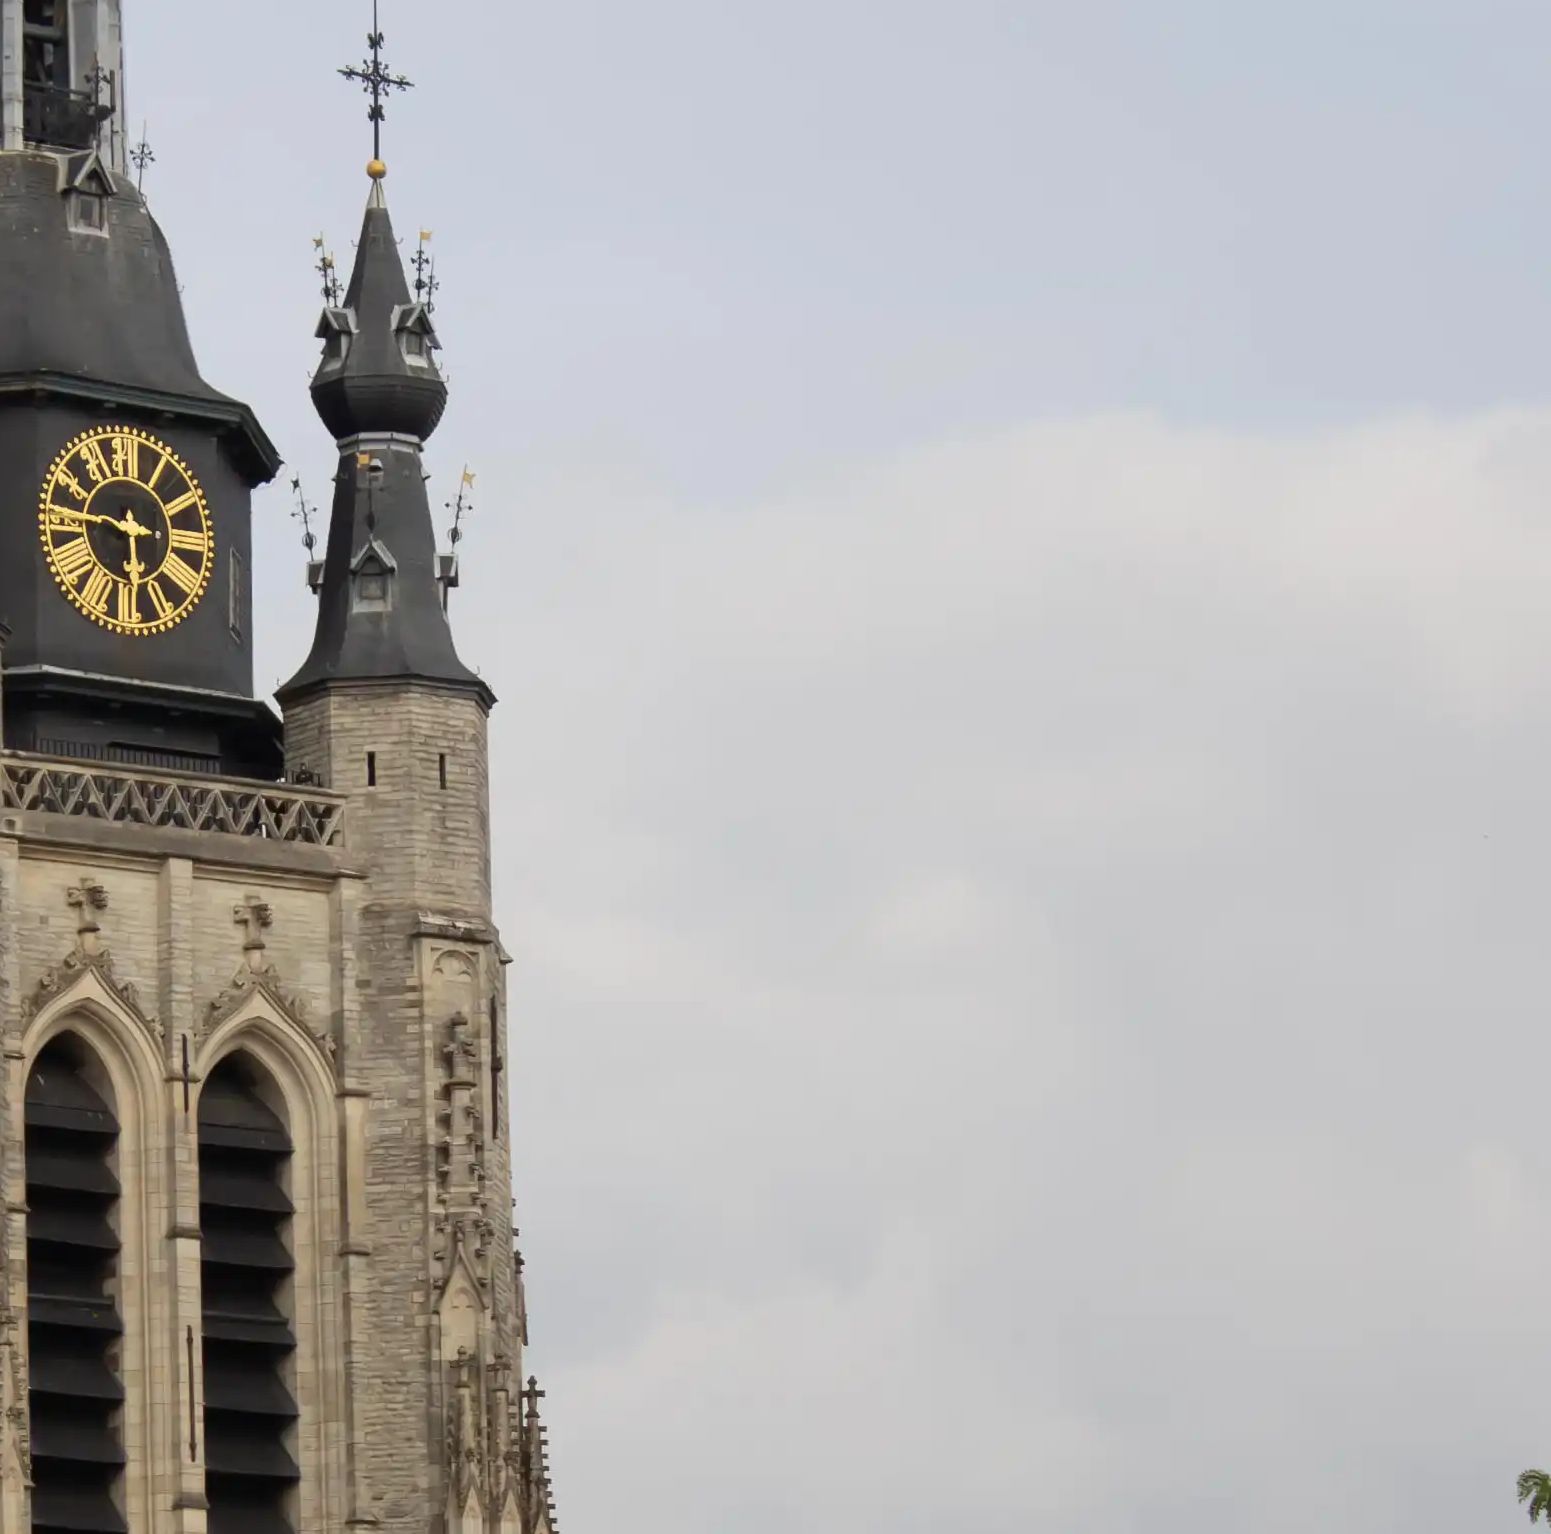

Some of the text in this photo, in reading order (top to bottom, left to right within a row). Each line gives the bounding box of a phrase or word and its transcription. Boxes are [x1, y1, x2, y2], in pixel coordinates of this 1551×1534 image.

[80, 440, 112, 482] XI
[112, 437, 139, 478] XII
[148, 456, 167, 488] I
[58, 466, 88, 500] X
[165, 490, 196, 516] II
[171, 529, 204, 552] III
[54, 537, 94, 584] VIII
[162, 552, 200, 594] IIII
[81, 566, 112, 613] VII
[147, 580, 174, 617] V
